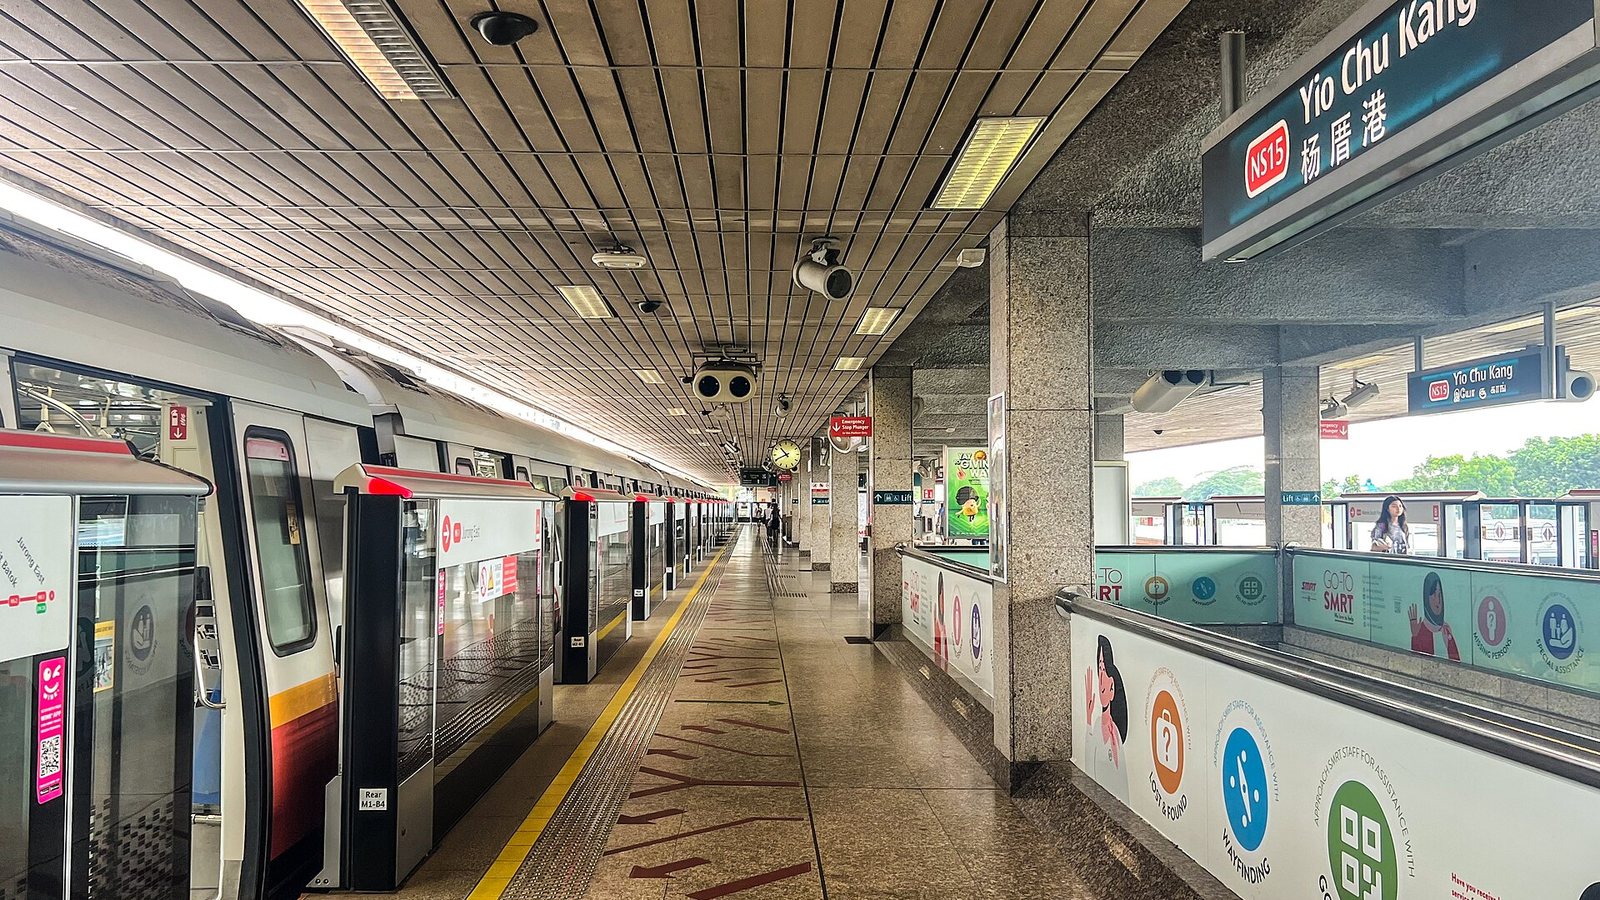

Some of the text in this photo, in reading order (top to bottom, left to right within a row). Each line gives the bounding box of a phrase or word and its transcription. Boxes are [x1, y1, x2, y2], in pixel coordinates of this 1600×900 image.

[1299, 0, 1478, 125] Yio Chu Kang
[1300, 88, 1388, 185] 杨厝港
[1250, 135, 1285, 183] NS15
[1453, 364, 1513, 386] Yio Chu Kang
[1431, 384, 1447, 400] NS15
[961, 460, 989, 469] GIVIN
[970, 469, 989, 478] WA
[901, 494, 912, 502] Lift
[1282, 494, 1294, 502] Lift
[16, 536, 35, 569] Jurong
[33, 564, 45, 585] East
[1, 560, 18, 588] Batok
[1301, 581, 1317, 592] SMRT
[1323, 569, 1354, 592] GO-TO
[1096, 585, 1123, 600] RT
[1323, 590, 1354, 615] SMRT
[1473, 631, 1513, 660] MISSING PERSONS
[1536, 638, 1585, 674] SPECIAL ASSISTANCE
[1149, 771, 1162, 807] LOST
[1167, 794, 1188, 821] FOUND
[1314, 746, 1415, 878] APPROACH SMRT STAFF FOR ASSISTANCE WITH
[1222, 828, 1271, 885] WAYFINDING
[1451, 872, 1465, 888] Have
[1466, 883, 1477, 893] you
